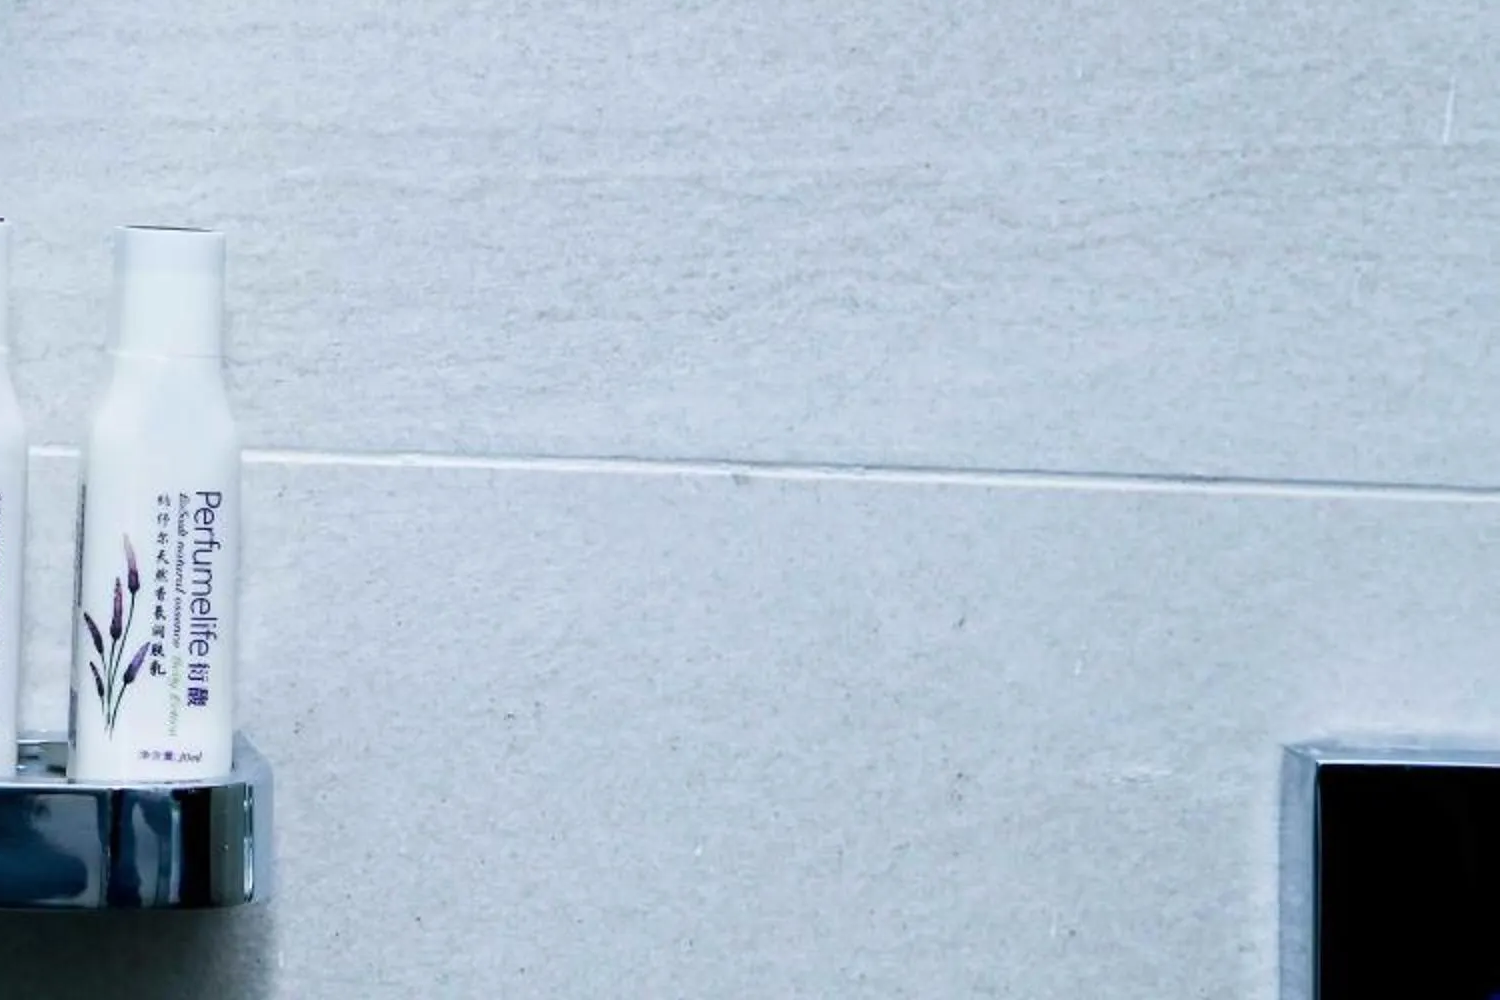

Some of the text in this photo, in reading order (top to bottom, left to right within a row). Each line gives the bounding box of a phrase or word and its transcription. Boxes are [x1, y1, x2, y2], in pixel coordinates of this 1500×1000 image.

[175, 541, 187, 595] natural
[187, 491, 222, 657] Perfumelife
[172, 596, 182, 648] essence
